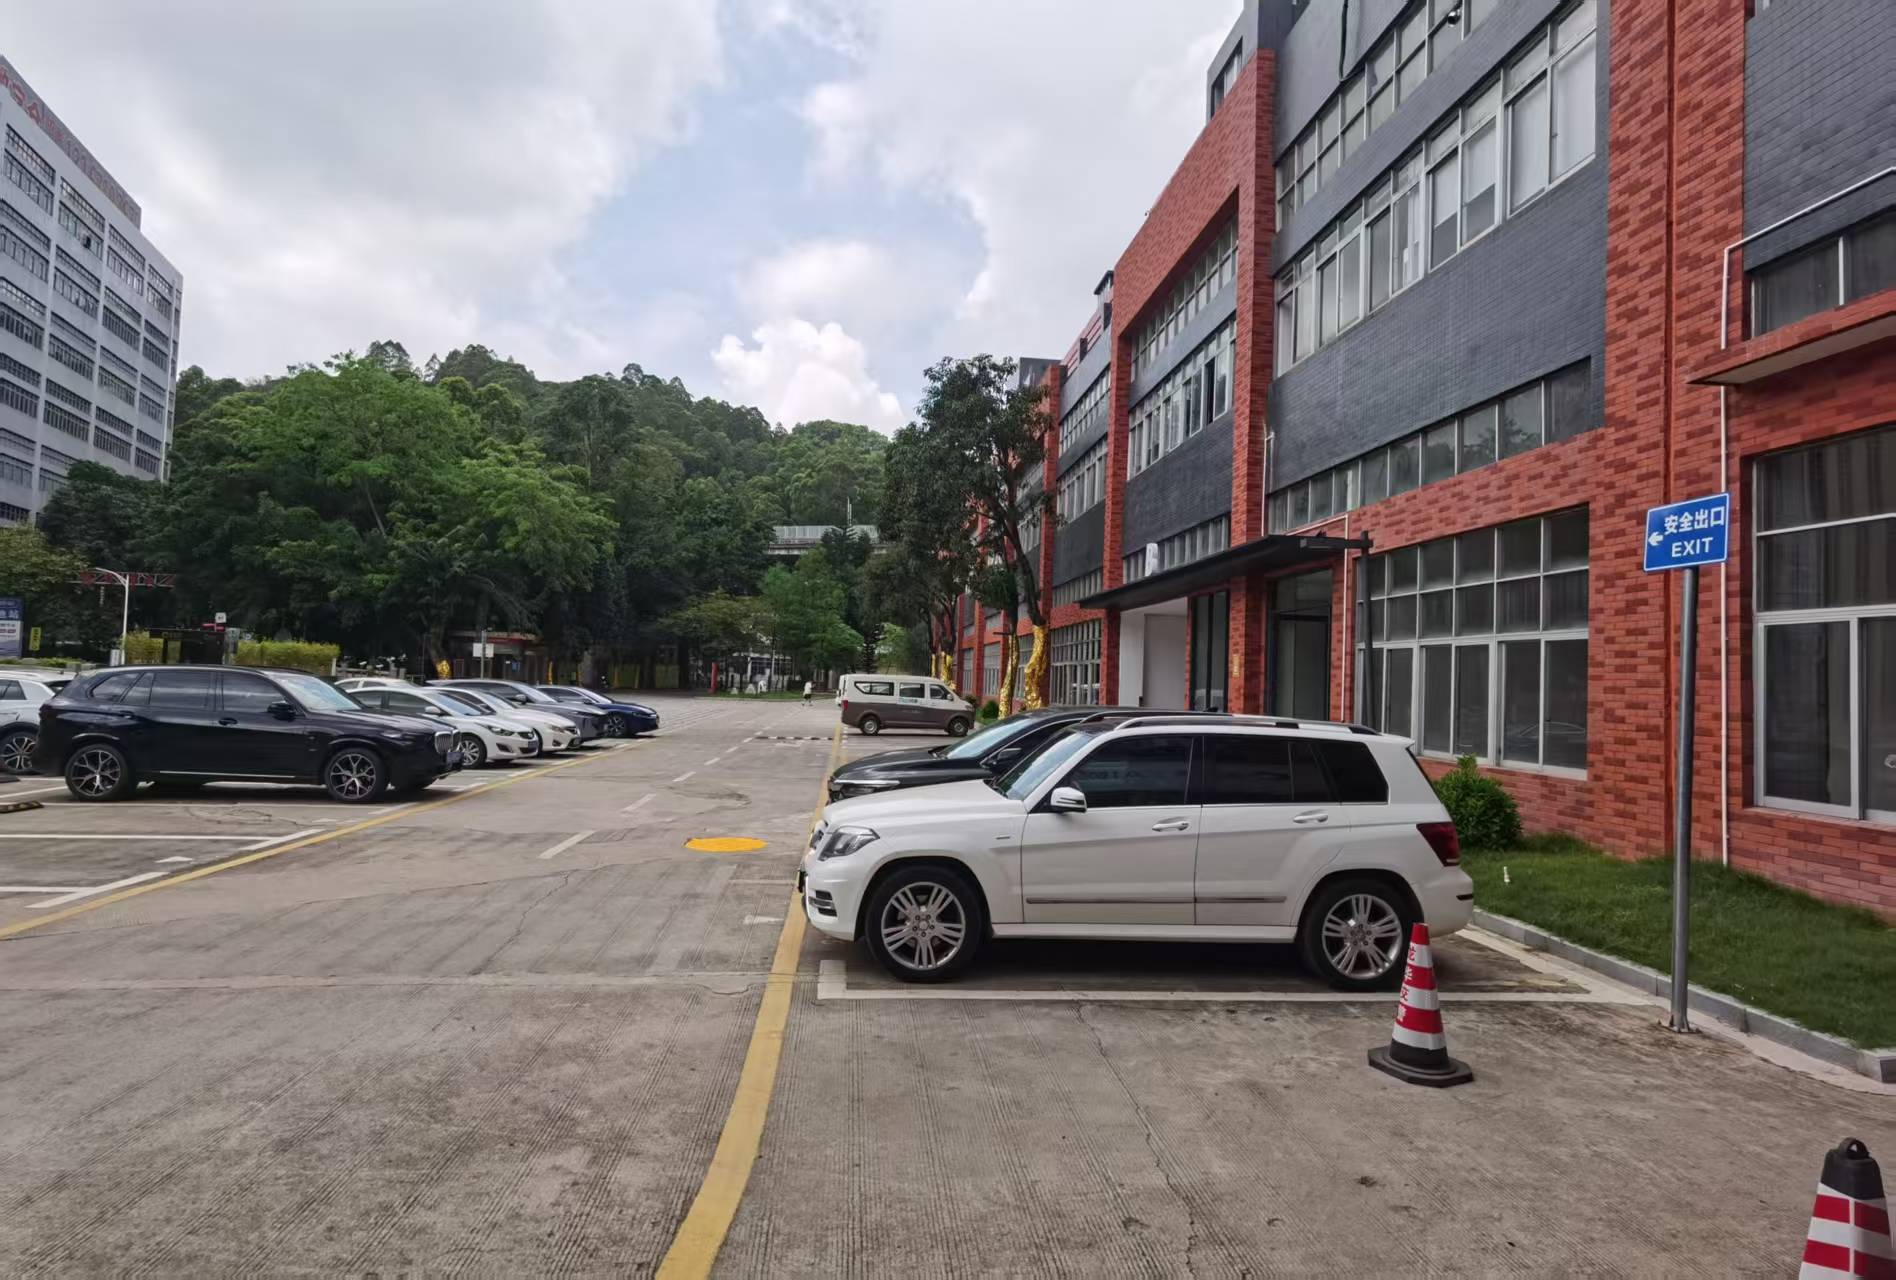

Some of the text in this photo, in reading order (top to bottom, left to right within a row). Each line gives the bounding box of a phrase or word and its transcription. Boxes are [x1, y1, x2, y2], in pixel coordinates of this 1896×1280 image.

[1664, 506, 1725, 535] 安全出口
[1671, 537, 1713, 558] EXIT
